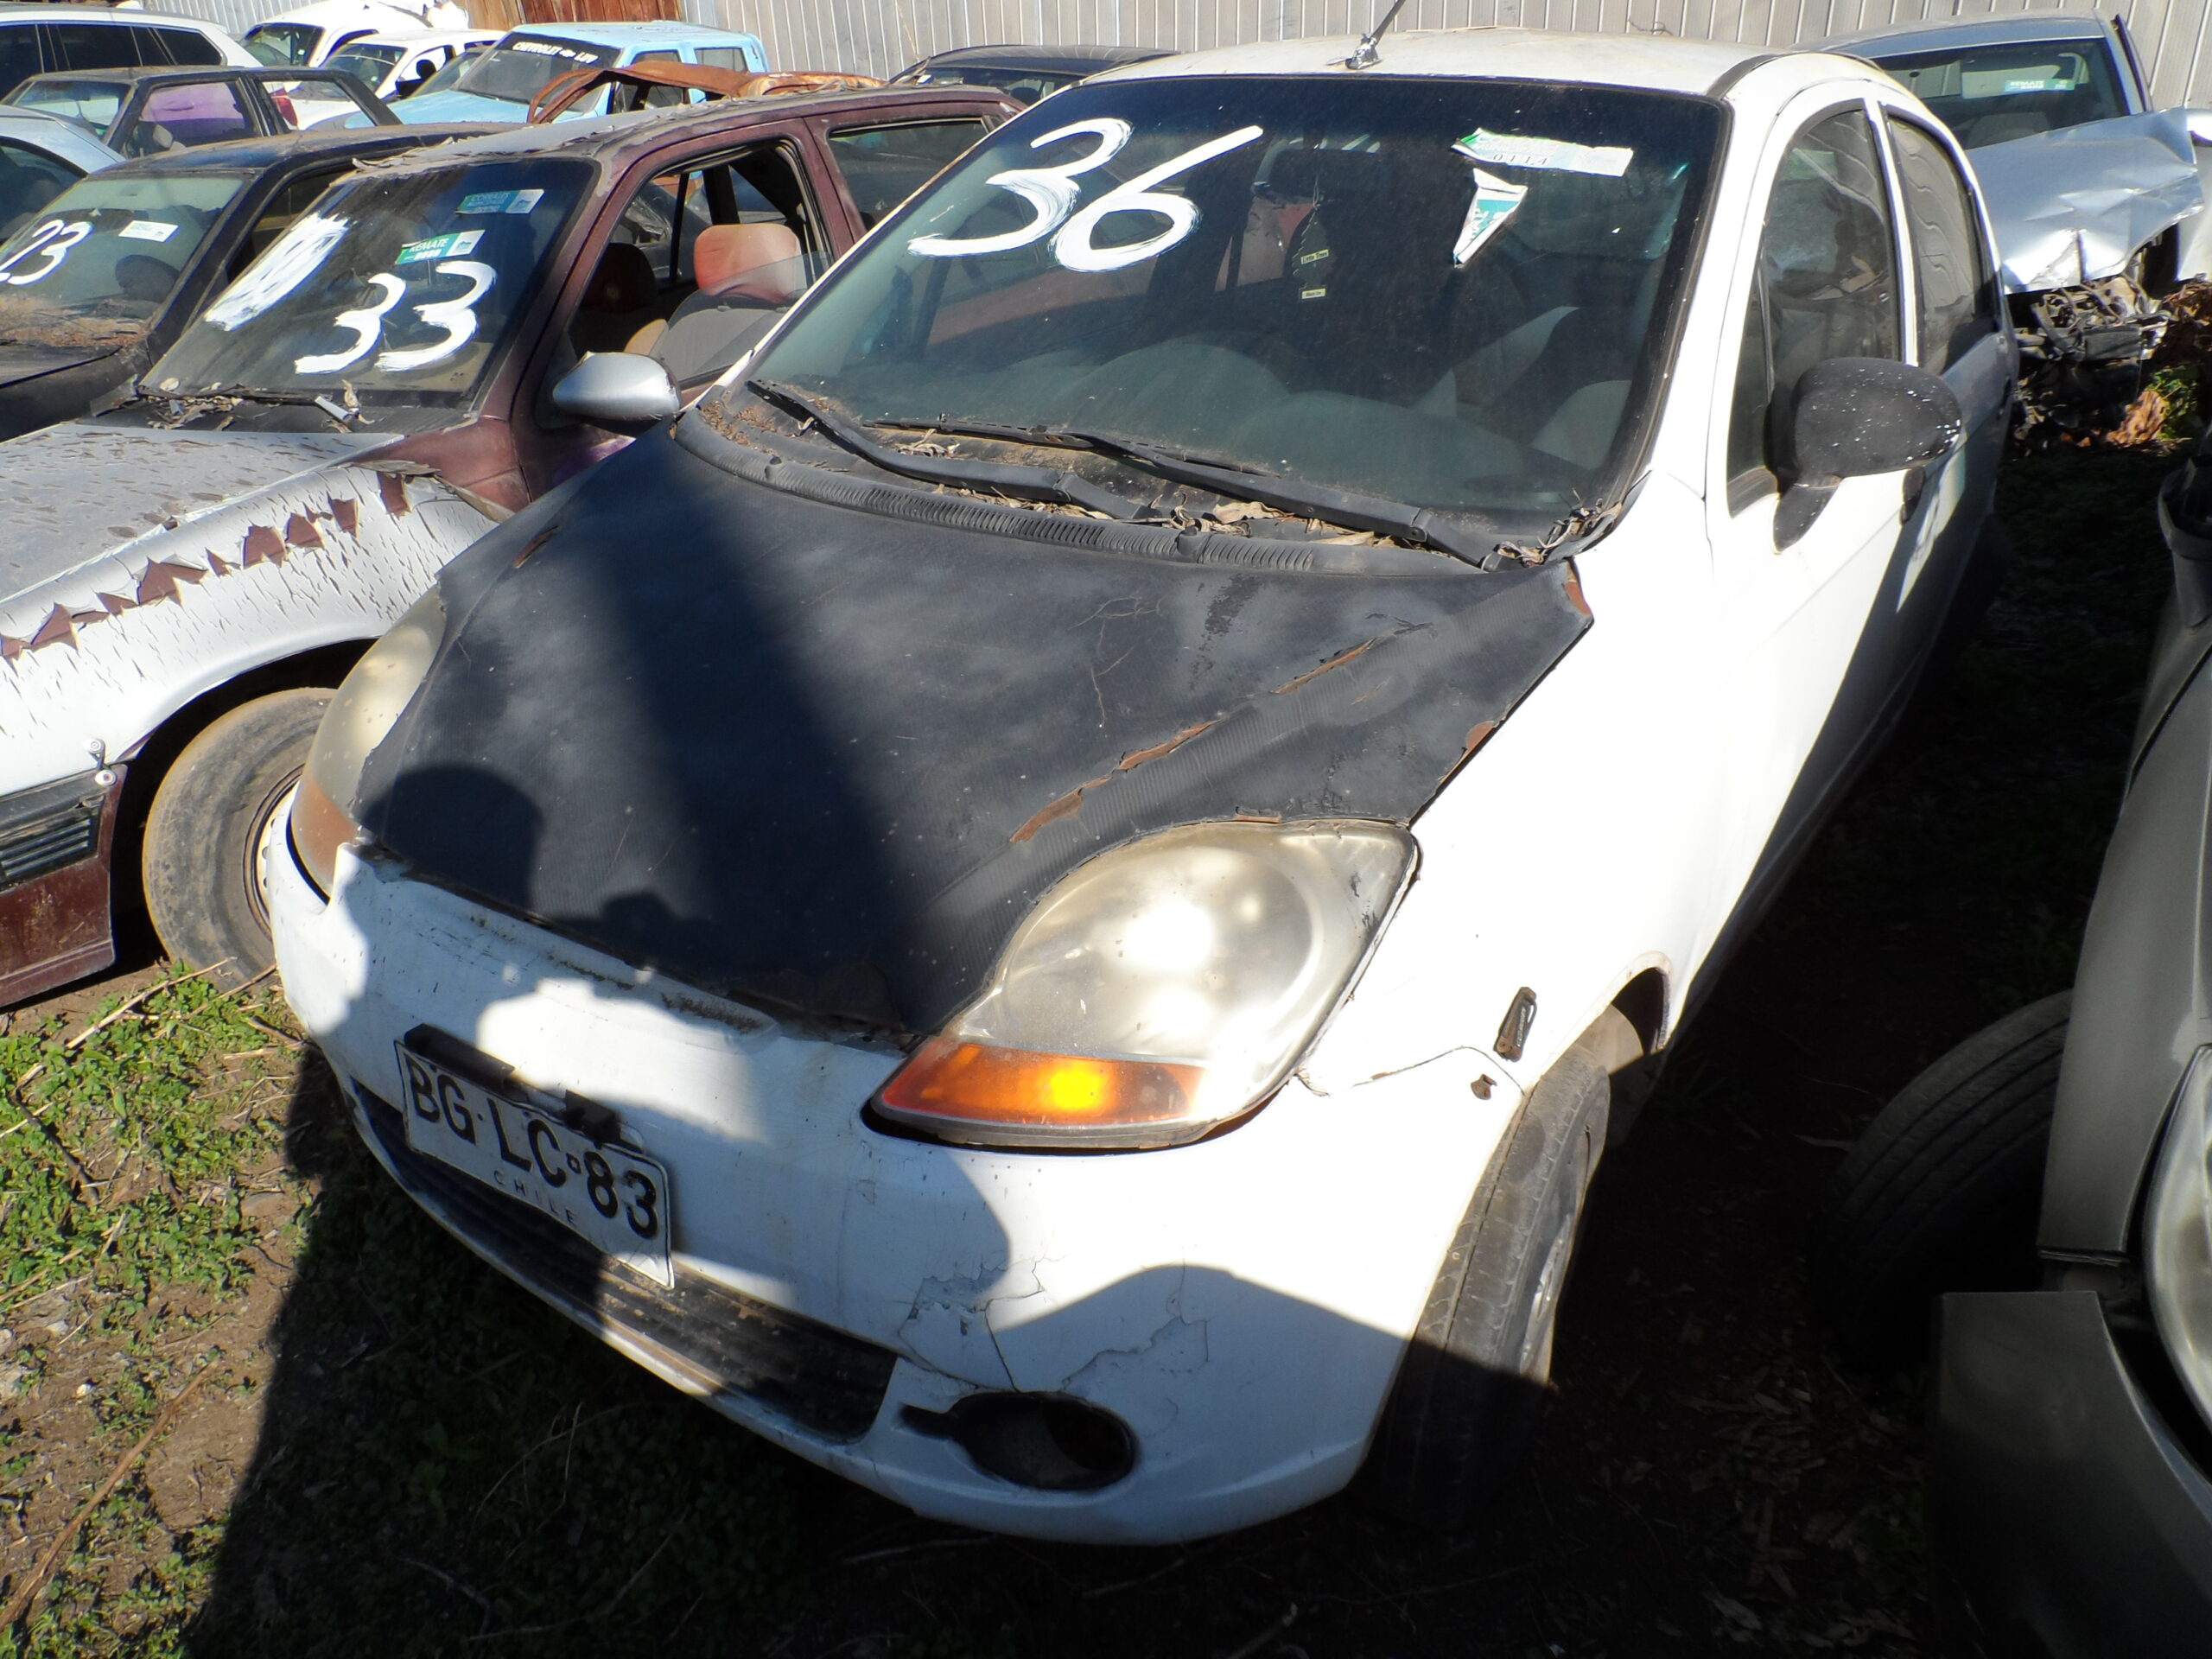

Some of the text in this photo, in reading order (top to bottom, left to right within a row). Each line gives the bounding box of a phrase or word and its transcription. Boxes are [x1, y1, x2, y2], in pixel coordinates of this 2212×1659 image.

[907, 118, 1264, 273] 36
[0, 219, 93, 285] 23
[294, 260, 498, 374] 33
[493, 1169, 577, 1225] CHILE
